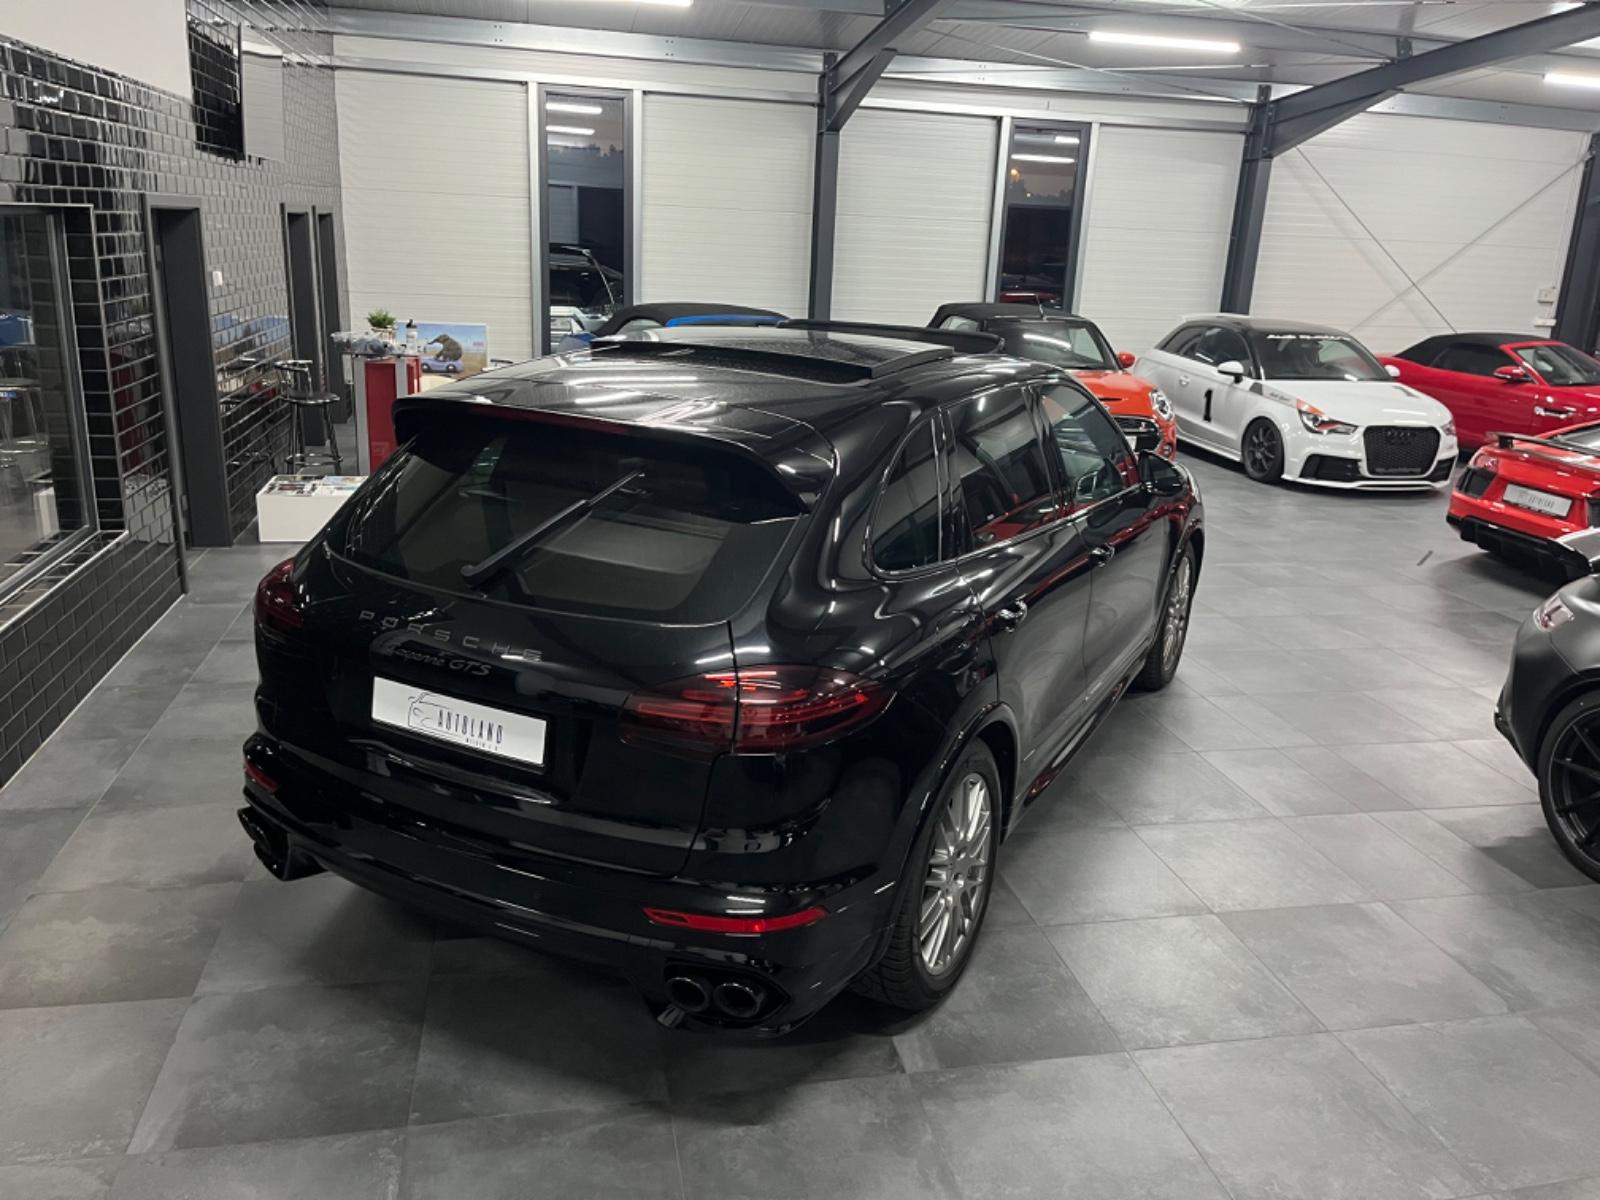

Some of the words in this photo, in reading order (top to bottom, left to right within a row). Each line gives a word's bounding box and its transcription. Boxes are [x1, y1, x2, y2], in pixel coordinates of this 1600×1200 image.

[1203, 389, 1213, 422] 1
[359, 609, 543, 662] PORSCHE
[449, 659, 492, 676] GTS
[438, 709, 503, 744] AUTOLAND
